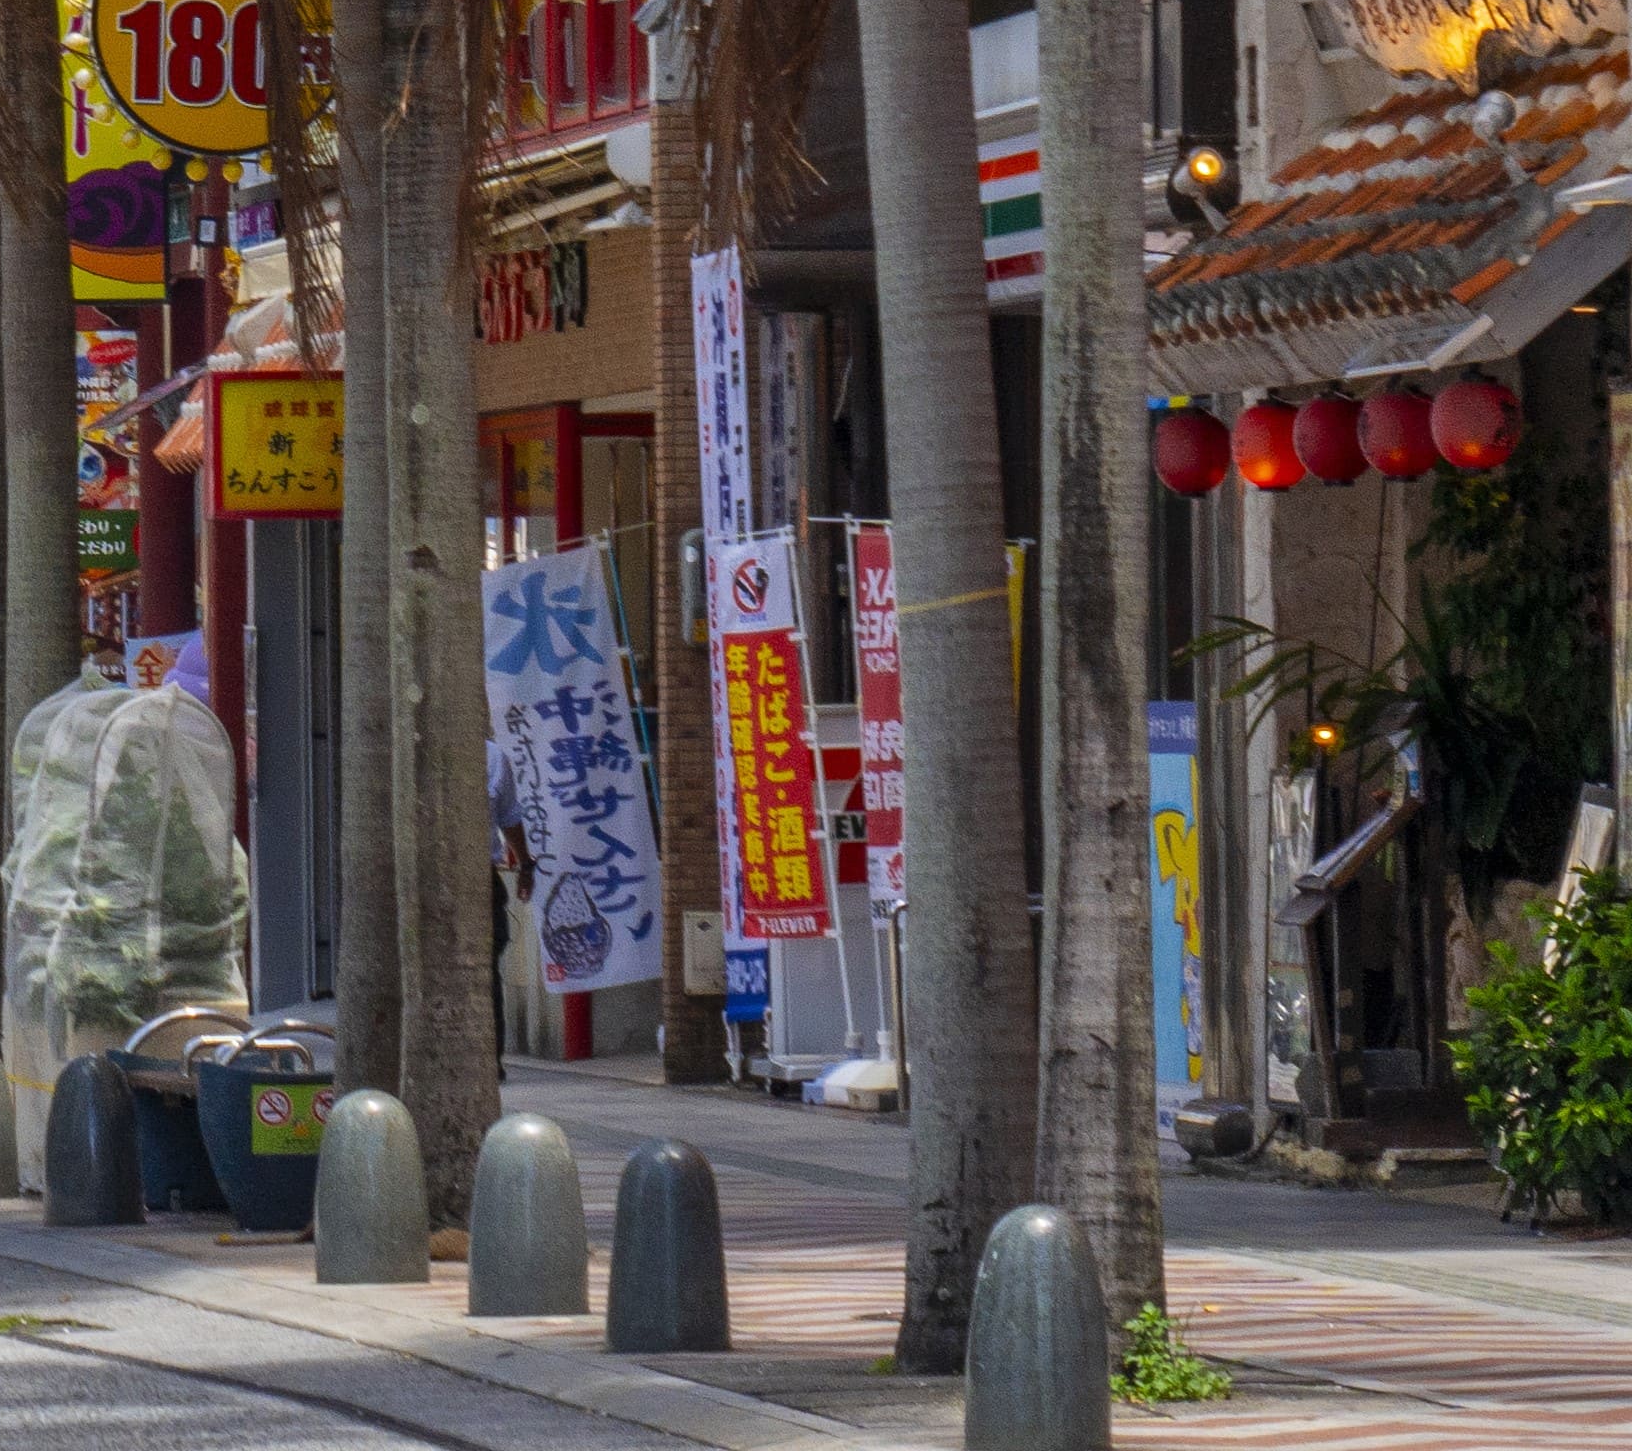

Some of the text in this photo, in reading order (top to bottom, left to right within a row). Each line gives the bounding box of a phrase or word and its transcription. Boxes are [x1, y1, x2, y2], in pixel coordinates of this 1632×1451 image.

[756, 642, 812, 901] たばこ・酒類
